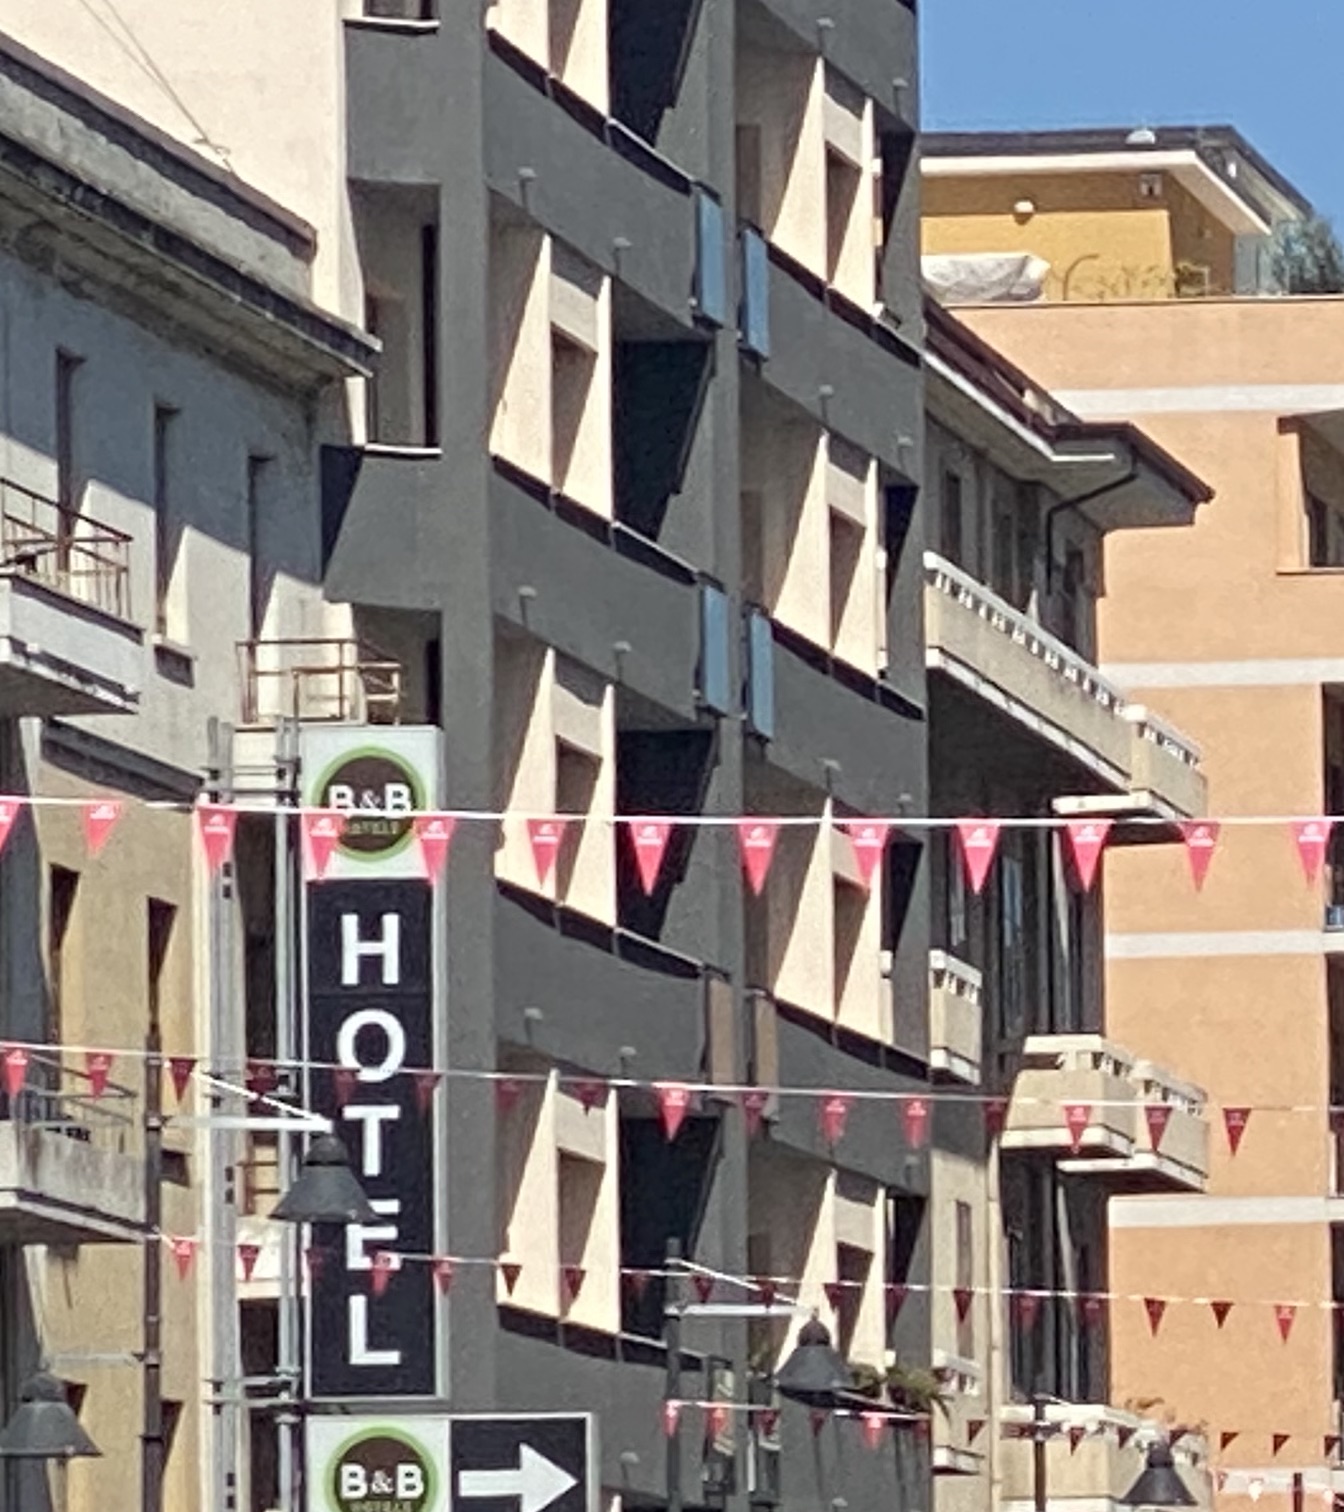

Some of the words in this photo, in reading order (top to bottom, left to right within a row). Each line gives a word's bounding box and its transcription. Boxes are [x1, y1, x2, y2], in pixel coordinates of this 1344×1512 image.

[328, 783, 412, 818] B&B
[336, 912, 407, 1367] HOTEL
[340, 1463, 425, 1500] B&B
